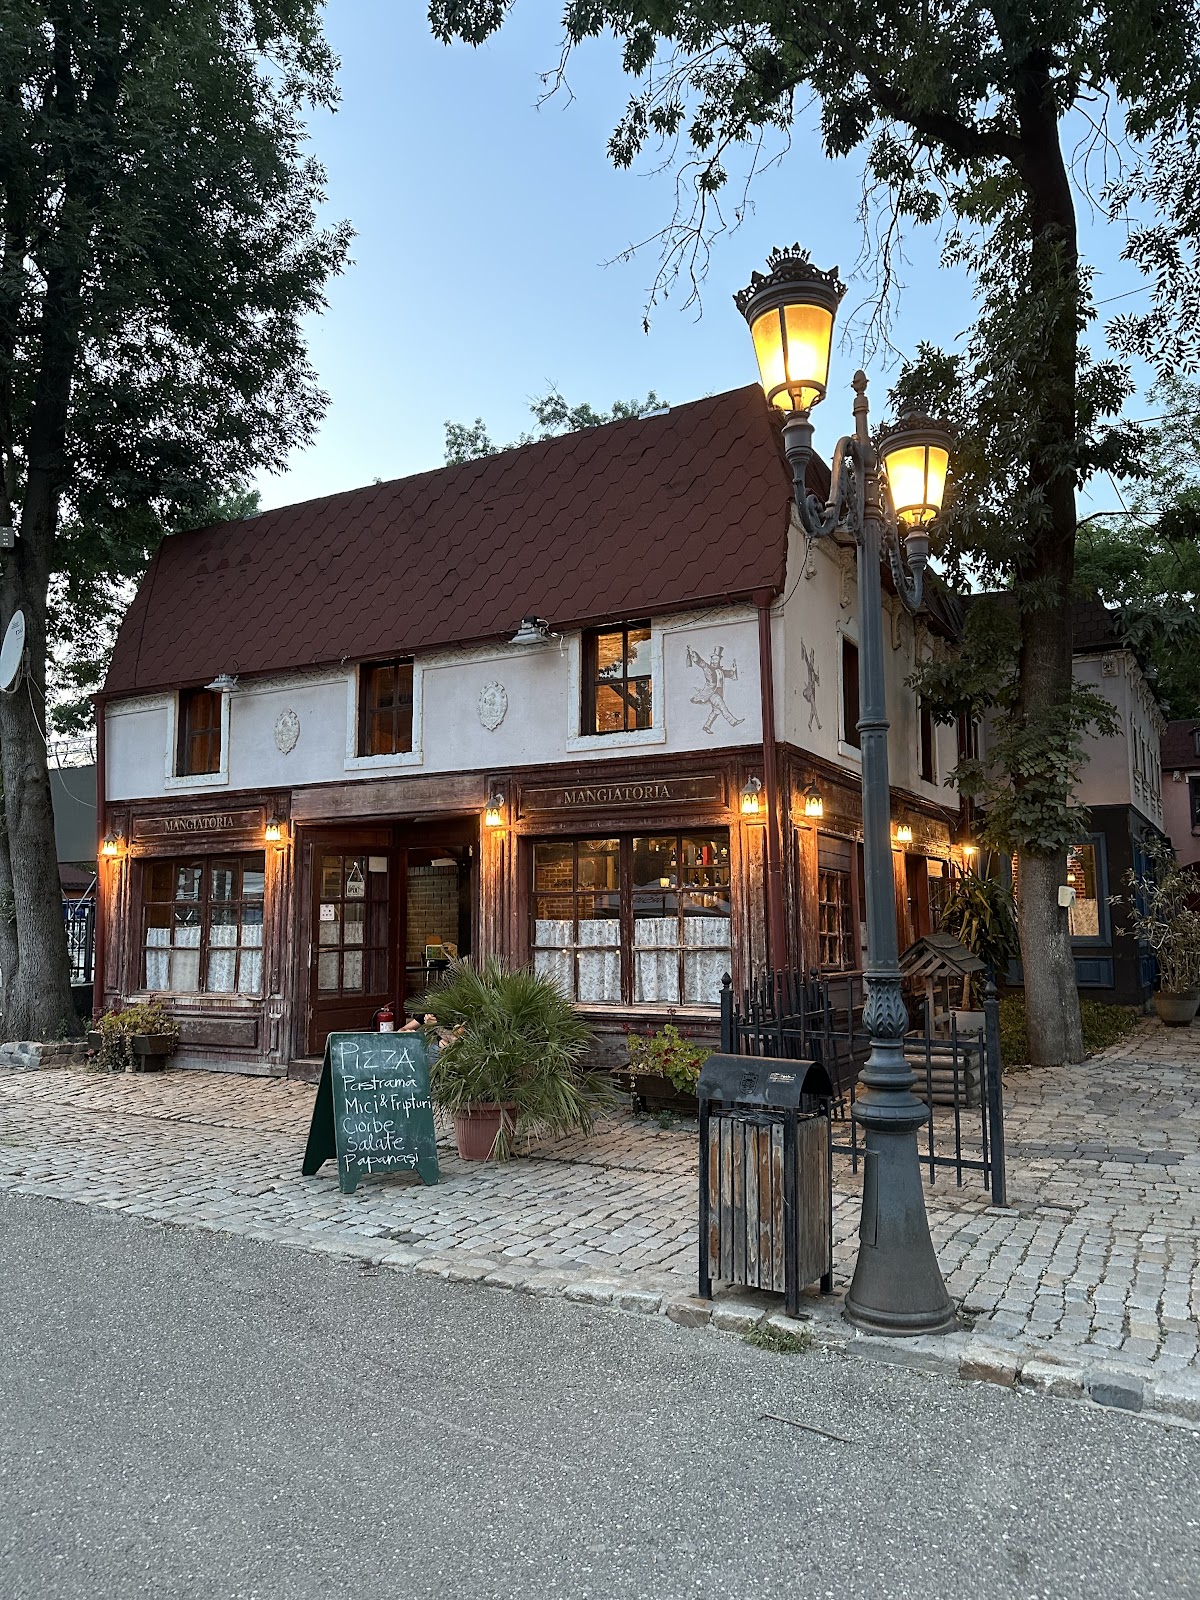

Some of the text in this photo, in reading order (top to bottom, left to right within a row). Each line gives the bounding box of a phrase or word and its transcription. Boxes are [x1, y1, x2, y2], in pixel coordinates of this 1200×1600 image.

[564, 784, 671, 804] MANGIATORIA
[164, 816, 234, 832] MANGIATORIA
[345, 1093, 432, 1118] Mici & Fripturi
[342, 1117, 396, 1135] Ciorbe
[346, 1132, 406, 1153] Salate
